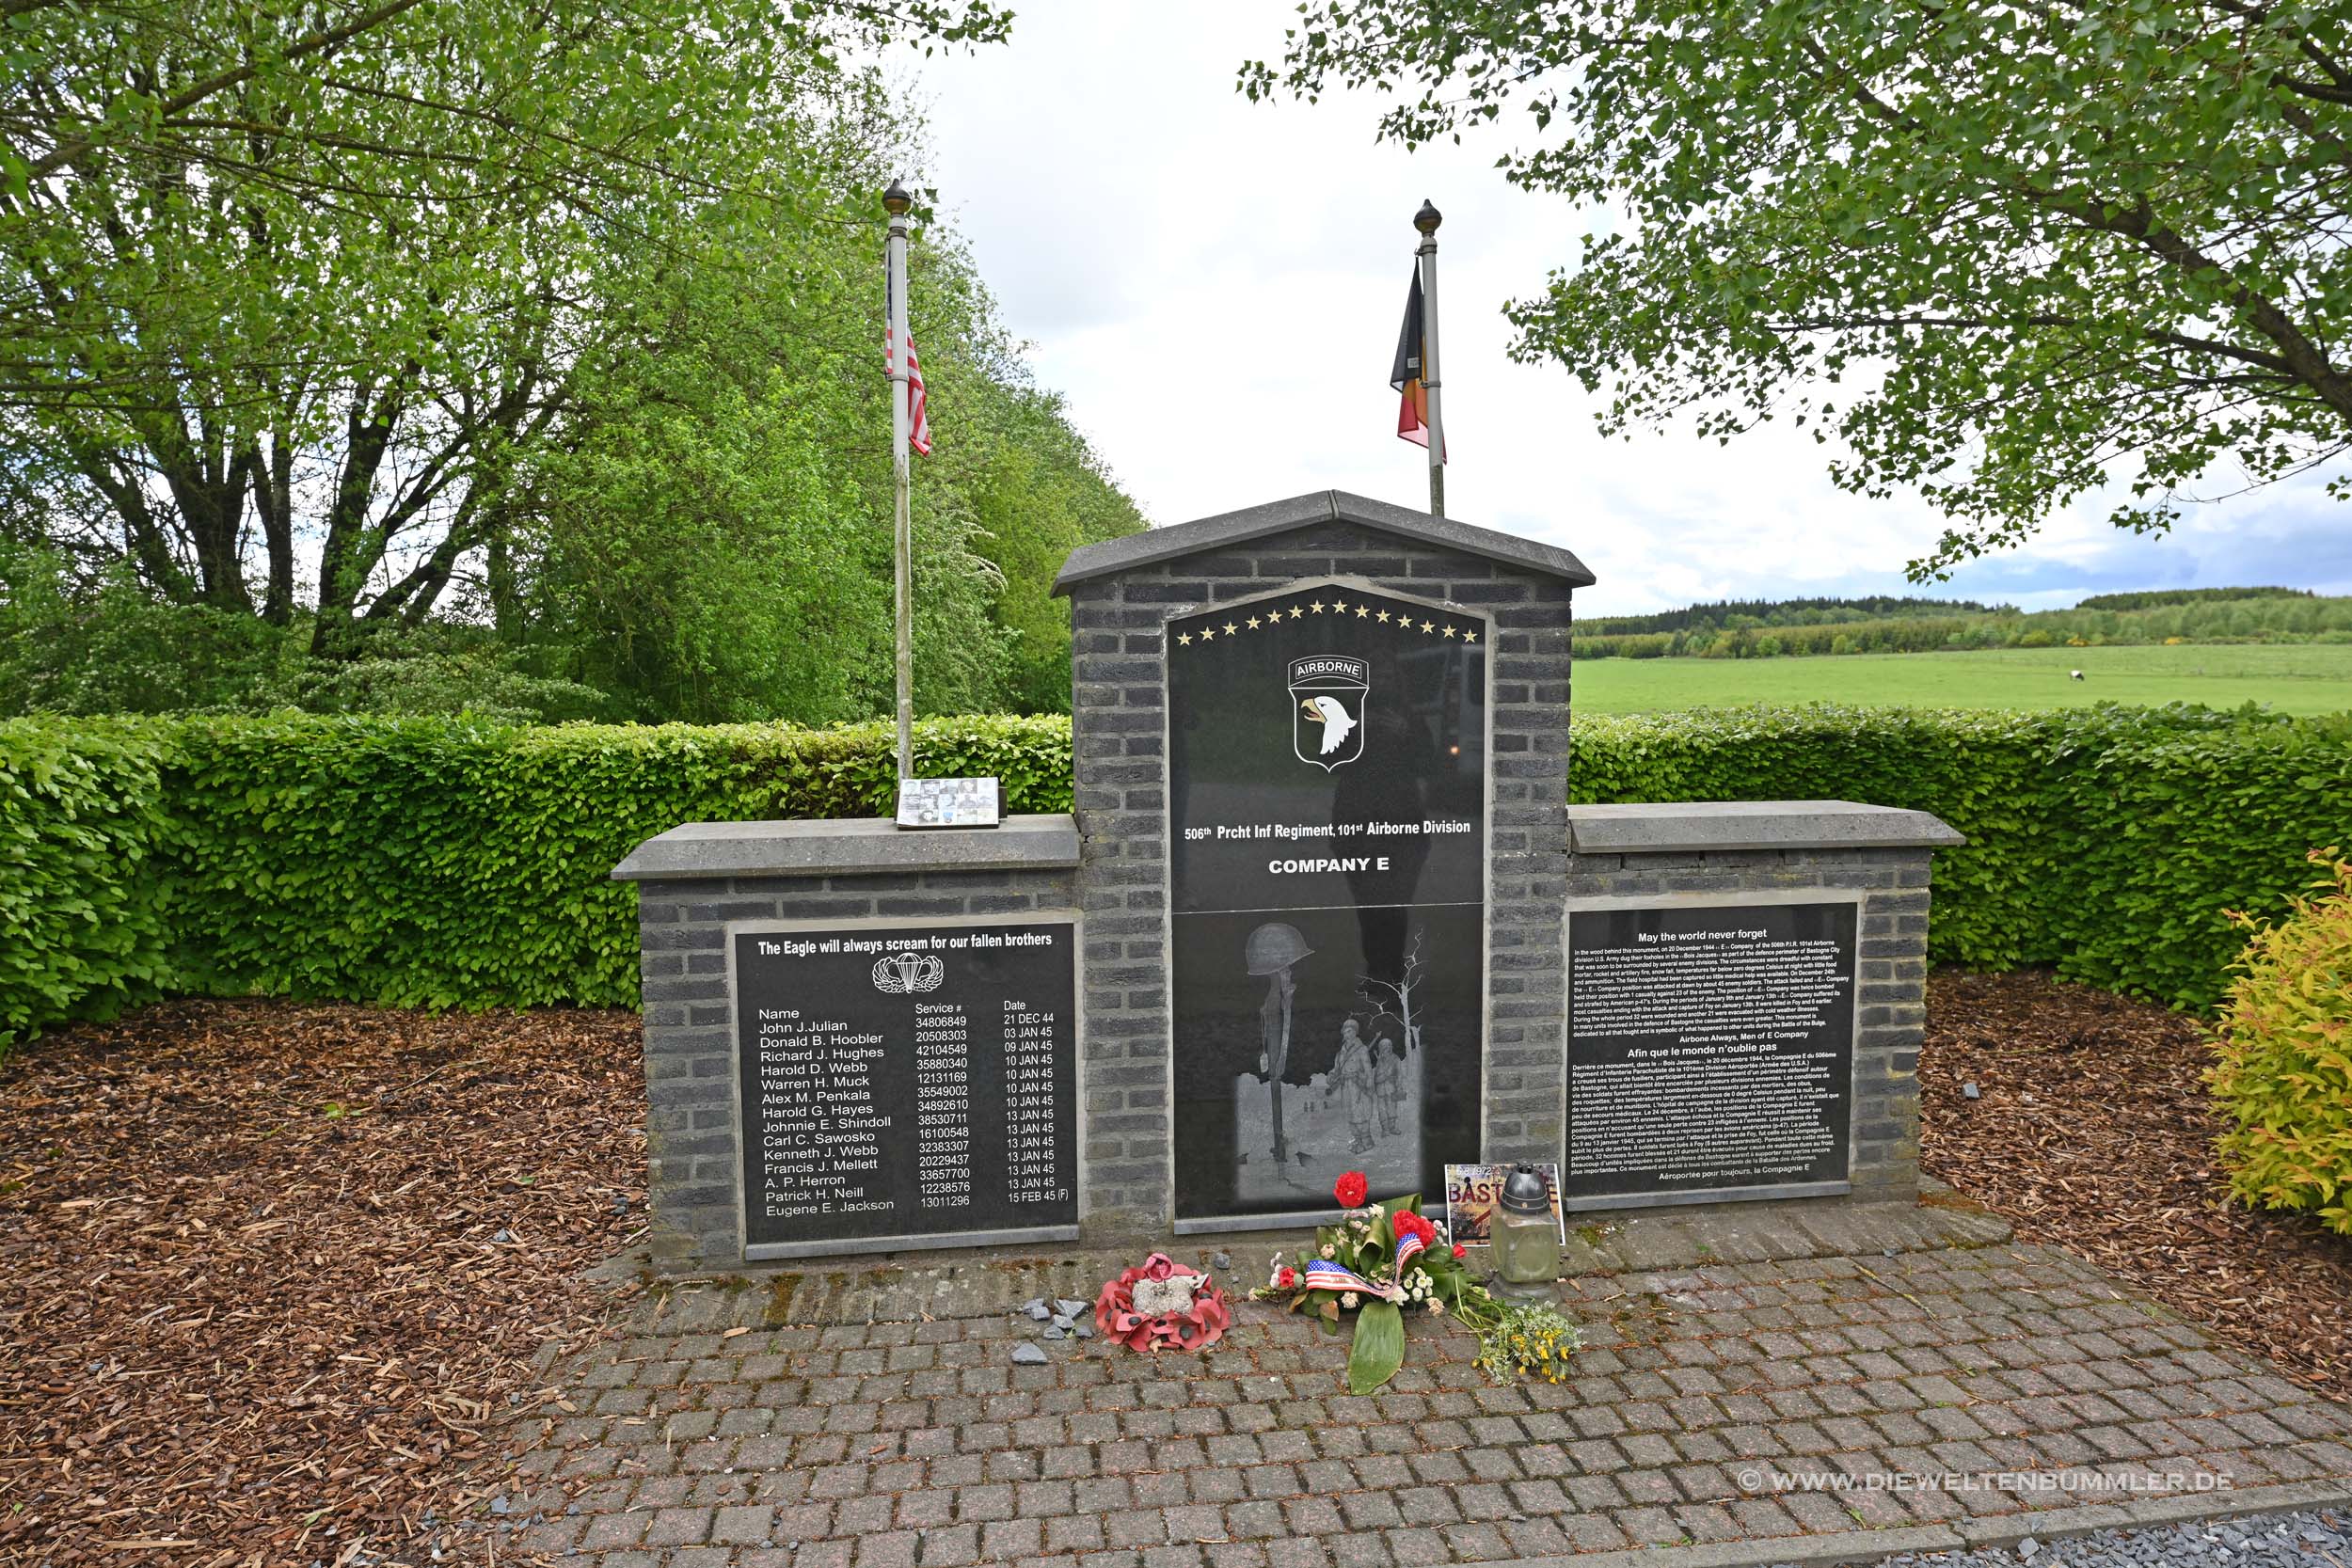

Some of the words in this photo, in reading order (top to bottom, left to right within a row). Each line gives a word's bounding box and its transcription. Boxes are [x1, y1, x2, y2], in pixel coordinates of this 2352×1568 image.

[1297, 661, 1360, 676] AIRBORNE
[1185, 828, 1211, 839] 506th
[1217, 826, 1250, 839] Prcht
[1255, 824, 1271, 837] Inf
[1275, 824, 1335, 840] Regiment,
[1338, 824, 1362, 835] 101st
[1367, 822, 1419, 834] Airborne
[1423, 820, 1470, 833] Division
[1269, 858, 1370, 873] COMPANY
[1377, 858, 1389, 870] E
[1639, 932, 1659, 944] May
[1661, 932, 1677, 942] the
[1678, 930, 1707, 942] world
[1708, 931, 1737, 940] never
[1738, 928, 1768, 941] forget
[758, 942, 780, 955] The
[785, 941, 816, 957] Eagle
[819, 940, 839, 952] will
[844, 939, 882, 954] always
[886, 940, 928, 950] scream
[931, 936, 946, 948] for
[950, 938, 968, 948] our
[971, 934, 1001, 947] fallen
[1006, 933, 1052, 946] brothers
[916, 1003, 953, 1014] Service
[956, 1004, 962, 1013] #
[1005, 1001, 1025, 1010] Date
[759, 1009, 799, 1020] Name
[1005, 1015, 1014, 1024] 21
[1019, 1013, 1040, 1023] DEC
[1042, 1013, 1054, 1022] 44
[916, 1016, 966, 1027] 34806849
[760, 1023, 791, 1034] John
[1005, 1028, 1016, 1038] 03
[1019, 1027, 1037, 1037] JAN
[1041, 1027, 1052, 1037] 45
[760, 1037, 807, 1048] Donald
[813, 1036, 825, 1045] B.
[832, 1034, 882, 1044] Hoobler
[916, 1030, 966, 1041] 20508303
[1710, 1034, 1740, 1043] Always,
[1740, 1032, 1756, 1040] Men
[1768, 1031, 1773, 1039] E
[1774, 1031, 1809, 1039] Company
[916, 1044, 967, 1055] 42104549
[1005, 1042, 1016, 1052] 09
[1019, 1041, 1038, 1052] JAN
[1041, 1040, 1052, 1050] 45
[1628, 1048, 1648, 1058] Afin
[1650, 1049, 1669, 1059] que
[1671, 1046, 1680, 1056] le
[1682, 1045, 1716, 1056] monde
[1759, 1043, 1777, 1054] pas
[761, 1050, 812, 1062] Richard
[817, 1050, 827, 1059] J.
[834, 1048, 884, 1060] Hughes
[1006, 1055, 1016, 1066] 10
[1019, 1055, 1038, 1065] JAN
[1041, 1054, 1052, 1064] 45
[762, 1065, 804, 1076] Harold
[811, 1064, 824, 1074] D.
[829, 1062, 867, 1072] Webb
[917, 1058, 967, 1069] 35880340
[918, 1072, 966, 1084] 12131169
[1007, 1069, 1016, 1079] 10
[1020, 1069, 1038, 1079] JAN
[1041, 1069, 1053, 1078] 45
[761, 1080, 809, 1090] Warren
[816, 1078, 828, 1087] H.
[834, 1076, 869, 1086] Muck
[1007, 1084, 1016, 1093] 10
[1020, 1083, 1039, 1093] JAN
[1041, 1082, 1053, 1091] 45
[762, 1094, 791, 1104] Alex
[796, 1093, 811, 1102] M.
[818, 1090, 869, 1101] Penkala
[918, 1085, 967, 1097] 35549002
[918, 1100, 968, 1111] 34892610
[1007, 1097, 1017, 1106] 10
[1020, 1097, 1039, 1106] JAN
[1041, 1096, 1053, 1105] 45
[763, 1106, 806, 1118] Harold
[812, 1106, 826, 1116] G.
[832, 1105, 873, 1117] Hayes
[1007, 1111, 1017, 1120] 13
[1020, 1110, 1039, 1120] JAN
[1042, 1109, 1053, 1118] 45
[763, 1121, 815, 1132] Johnnie
[820, 1119, 833, 1129] E.
[839, 1117, 890, 1129] Shindoll
[918, 1114, 966, 1125] 38530711
[920, 1127, 969, 1138] 16100548
[1007, 1125, 1018, 1134] 13
[1021, 1123, 1039, 1133] JAN
[1042, 1123, 1054, 1132] 45
[764, 1135, 790, 1146] Carl
[796, 1134, 809, 1145] C.
[815, 1132, 875, 1144] Sawosko
[1008, 1138, 1018, 1148] 13
[1021, 1137, 1040, 1148] JAN
[1042, 1136, 1054, 1146] 45
[919, 1141, 969, 1152] 32383307
[765, 1148, 819, 1160] Kenneth
[824, 1148, 834, 1157] J.
[840, 1146, 878, 1156] Webb
[1008, 1152, 1018, 1162] 13
[1022, 1151, 1040, 1161] JAN
[1042, 1150, 1054, 1160] 45
[920, 1154, 969, 1166] 20229437
[765, 1163, 813, 1174] Francis
[818, 1162, 828, 1171] J.
[834, 1159, 877, 1170] Mellett
[1009, 1165, 1018, 1175] 13
[1022, 1164, 1040, 1175] JAN
[1042, 1164, 1054, 1173] 45
[1659, 1171, 1701, 1180] Aéroportée
[1702, 1170, 1720, 1179] pour
[1721, 1167, 1753, 1178] toujours,
[1755, 1166, 1761, 1175] la
[1762, 1164, 1804, 1175] Compagnie
[1804, 1163, 1811, 1171] E
[920, 1168, 969, 1180] 33657700
[765, 1179, 778, 1188] A.
[785, 1178, 795, 1187] P.
[801, 1176, 845, 1186] Herron
[921, 1181, 970, 1194] 12238576
[1009, 1180, 1019, 1189] 13
[1022, 1178, 1040, 1188] JAN
[1043, 1178, 1055, 1187] 45
[766, 1191, 811, 1202] Patrick
[817, 1189, 830, 1199] H.
[835, 1187, 863, 1198] Neill
[1009, 1193, 1019, 1202] 15
[1022, 1192, 1041, 1201] FEB
[1044, 1191, 1055, 1200] 45
[1058, 1189, 1068, 1200] (F)
[921, 1196, 969, 1207] 13011296
[767, 1206, 818, 1217] Eugene
[822, 1203, 835, 1212] E.
[840, 1201, 894, 1212] Jackson
